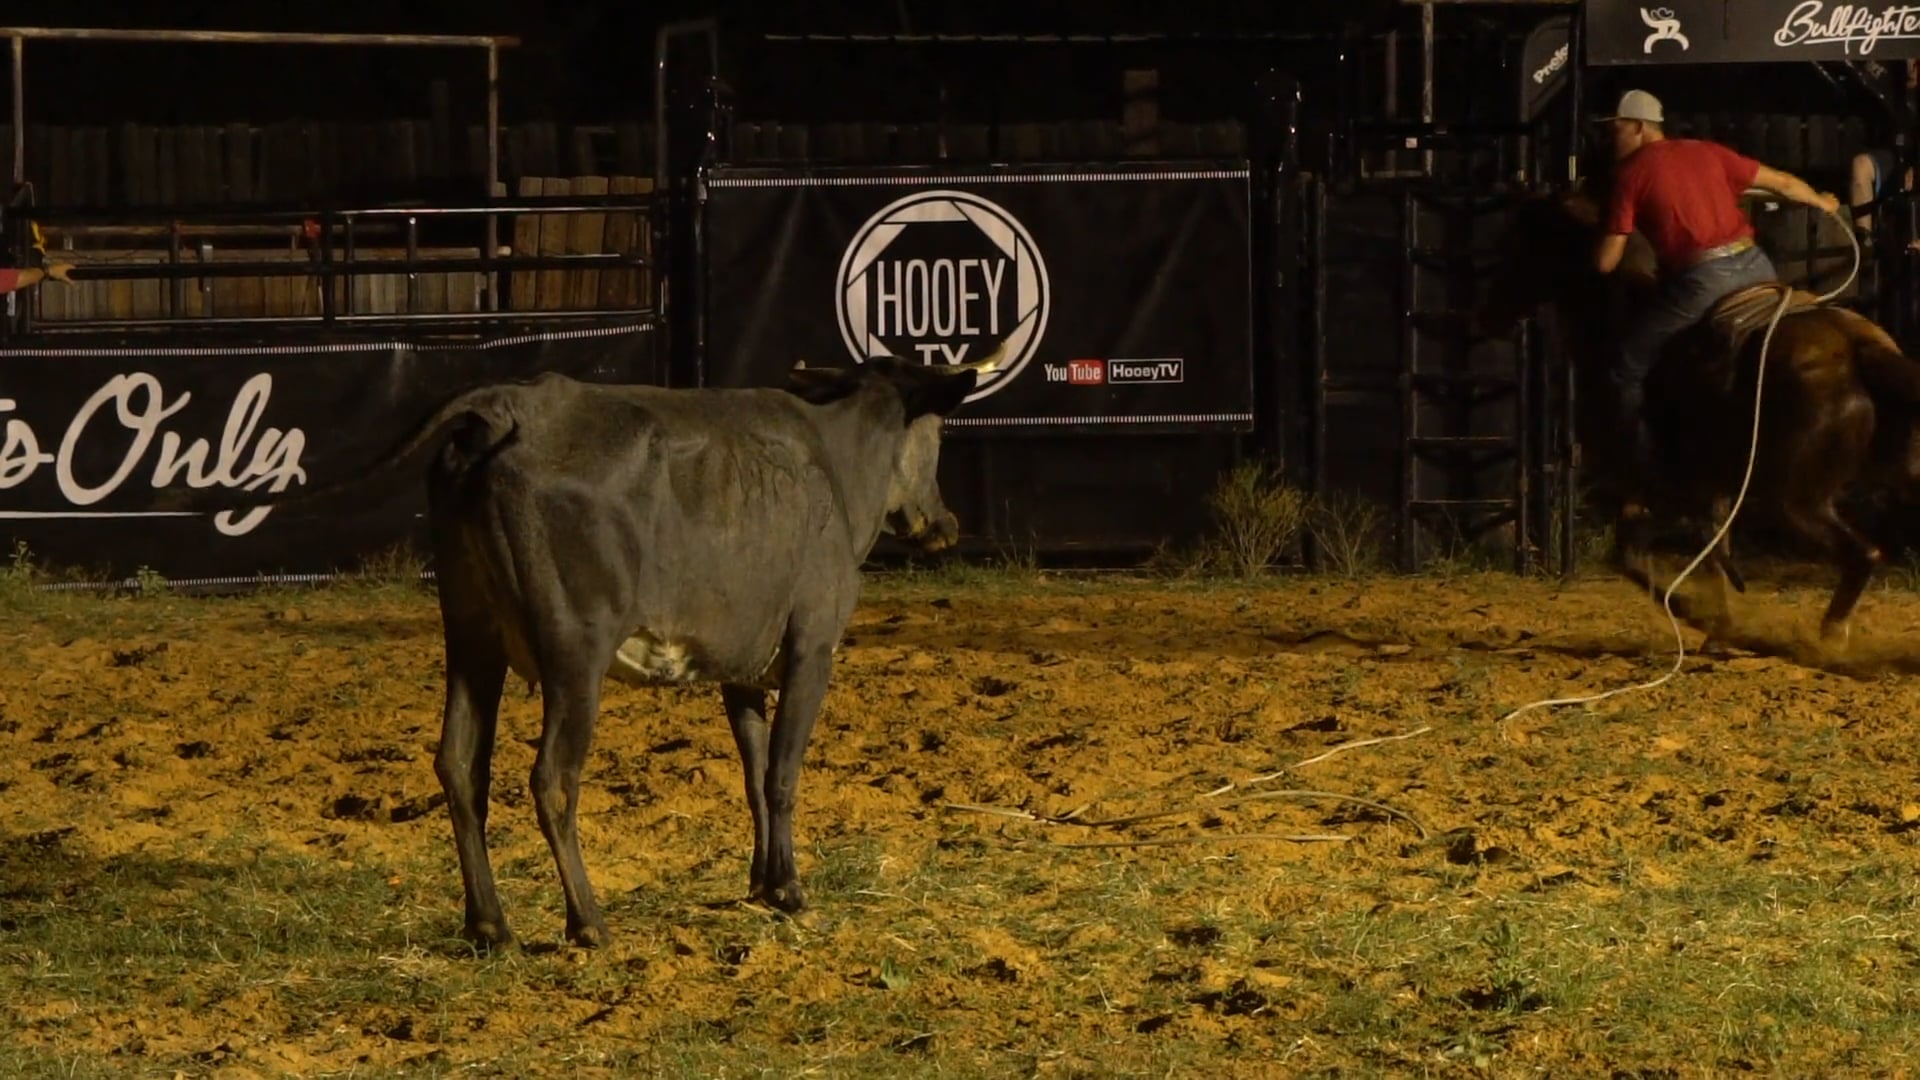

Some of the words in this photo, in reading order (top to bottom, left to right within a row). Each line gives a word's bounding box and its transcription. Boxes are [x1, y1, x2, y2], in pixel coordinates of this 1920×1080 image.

[876, 257, 1006, 338] HOOEY
[914, 343, 971, 367] TV
[1044, 362, 1101, 382] YouTube
[1112, 363, 1180, 380] HooeyTV
[55, 371, 307, 537] Only
